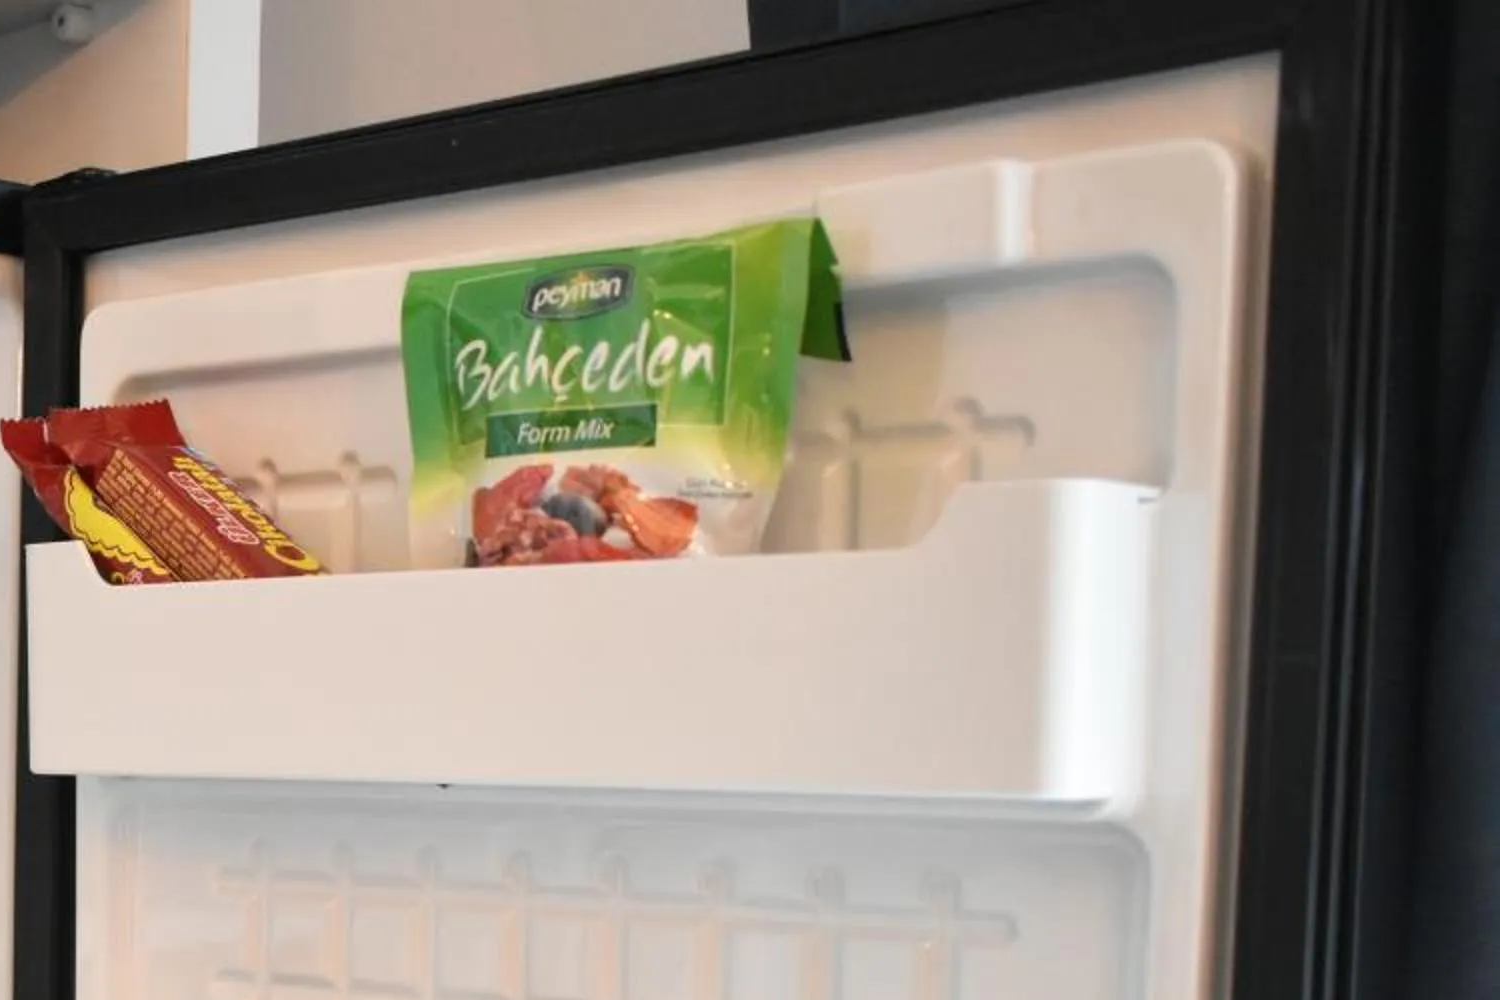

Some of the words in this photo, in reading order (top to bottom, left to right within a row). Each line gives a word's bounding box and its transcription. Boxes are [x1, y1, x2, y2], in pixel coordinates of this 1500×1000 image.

[532, 276, 622, 311] peyman
[454, 317, 715, 411] Bahçeden
[516, 422, 570, 445] Form
[574, 418, 615, 440] Mix
